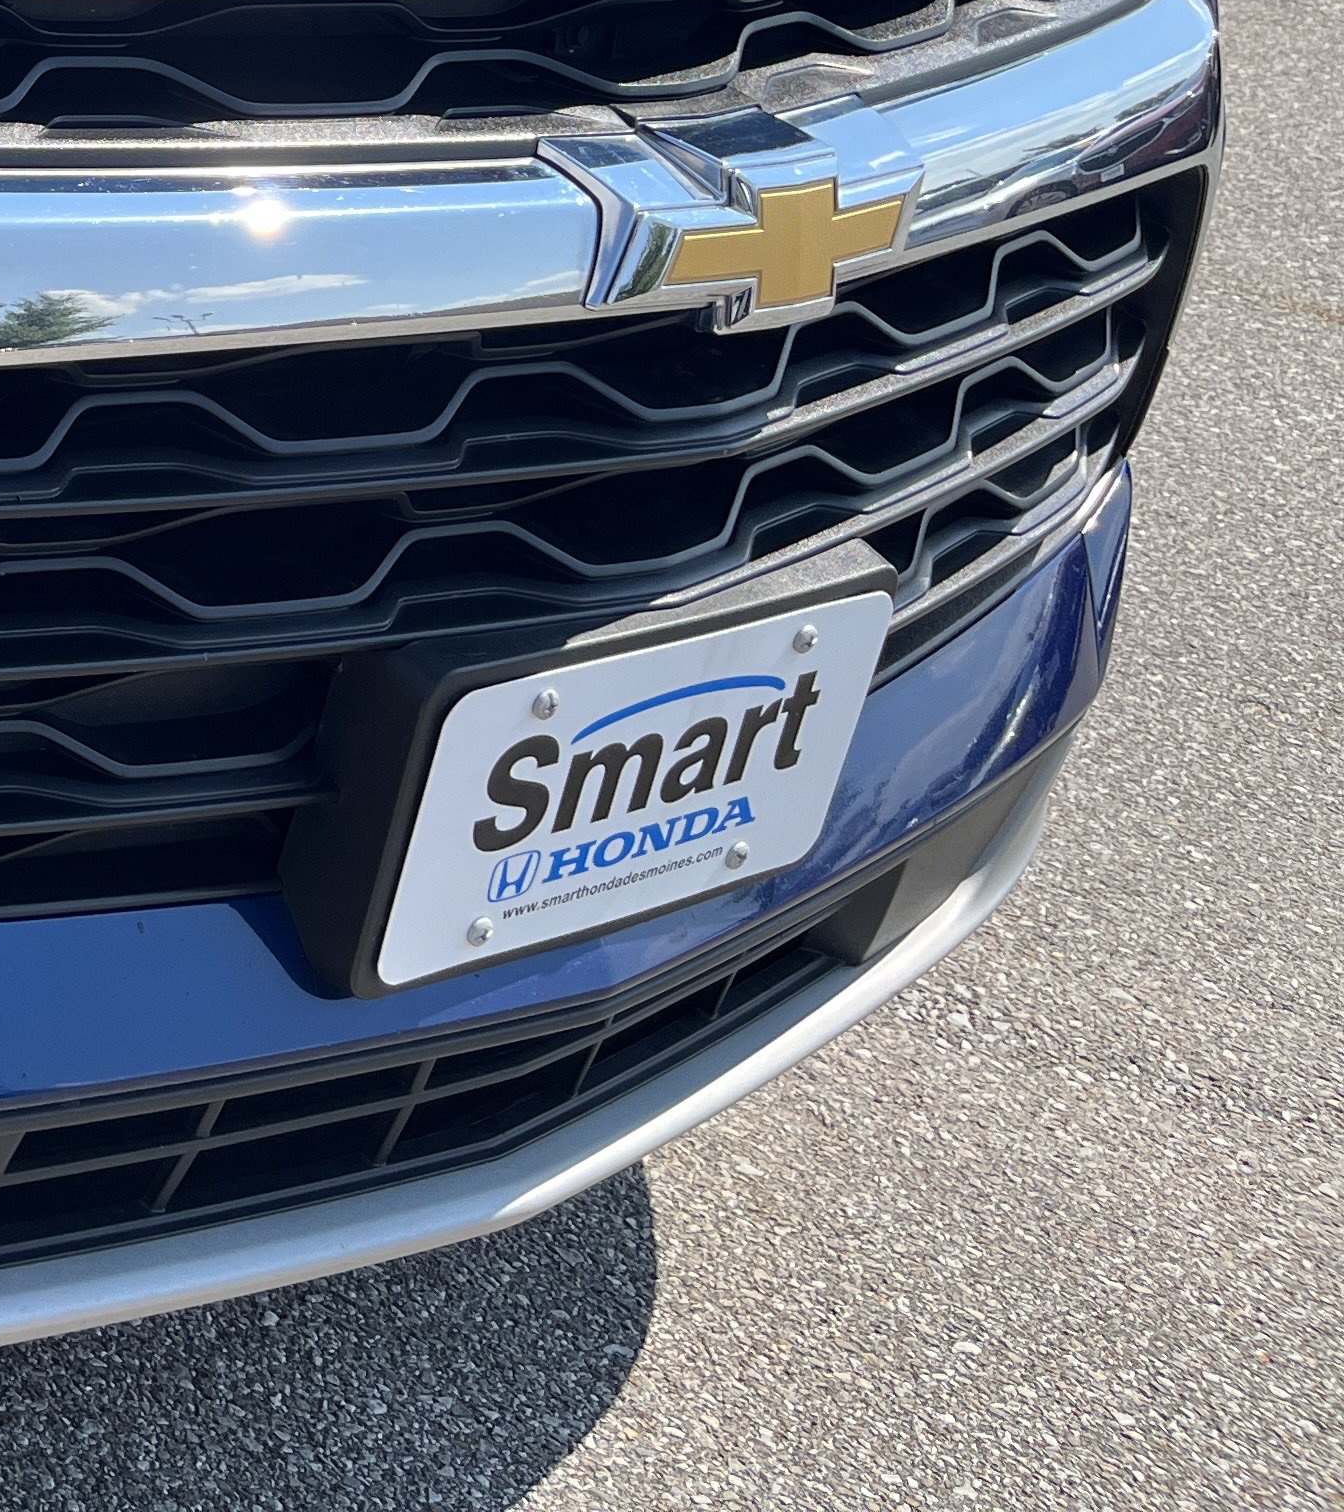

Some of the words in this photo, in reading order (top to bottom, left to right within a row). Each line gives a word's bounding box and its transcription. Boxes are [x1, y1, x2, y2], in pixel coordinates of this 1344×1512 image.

[472, 670, 822, 852] Smart
[502, 845, 724, 920] www.smarthondadesmoines.com
[542, 796, 756, 884] HONDA
